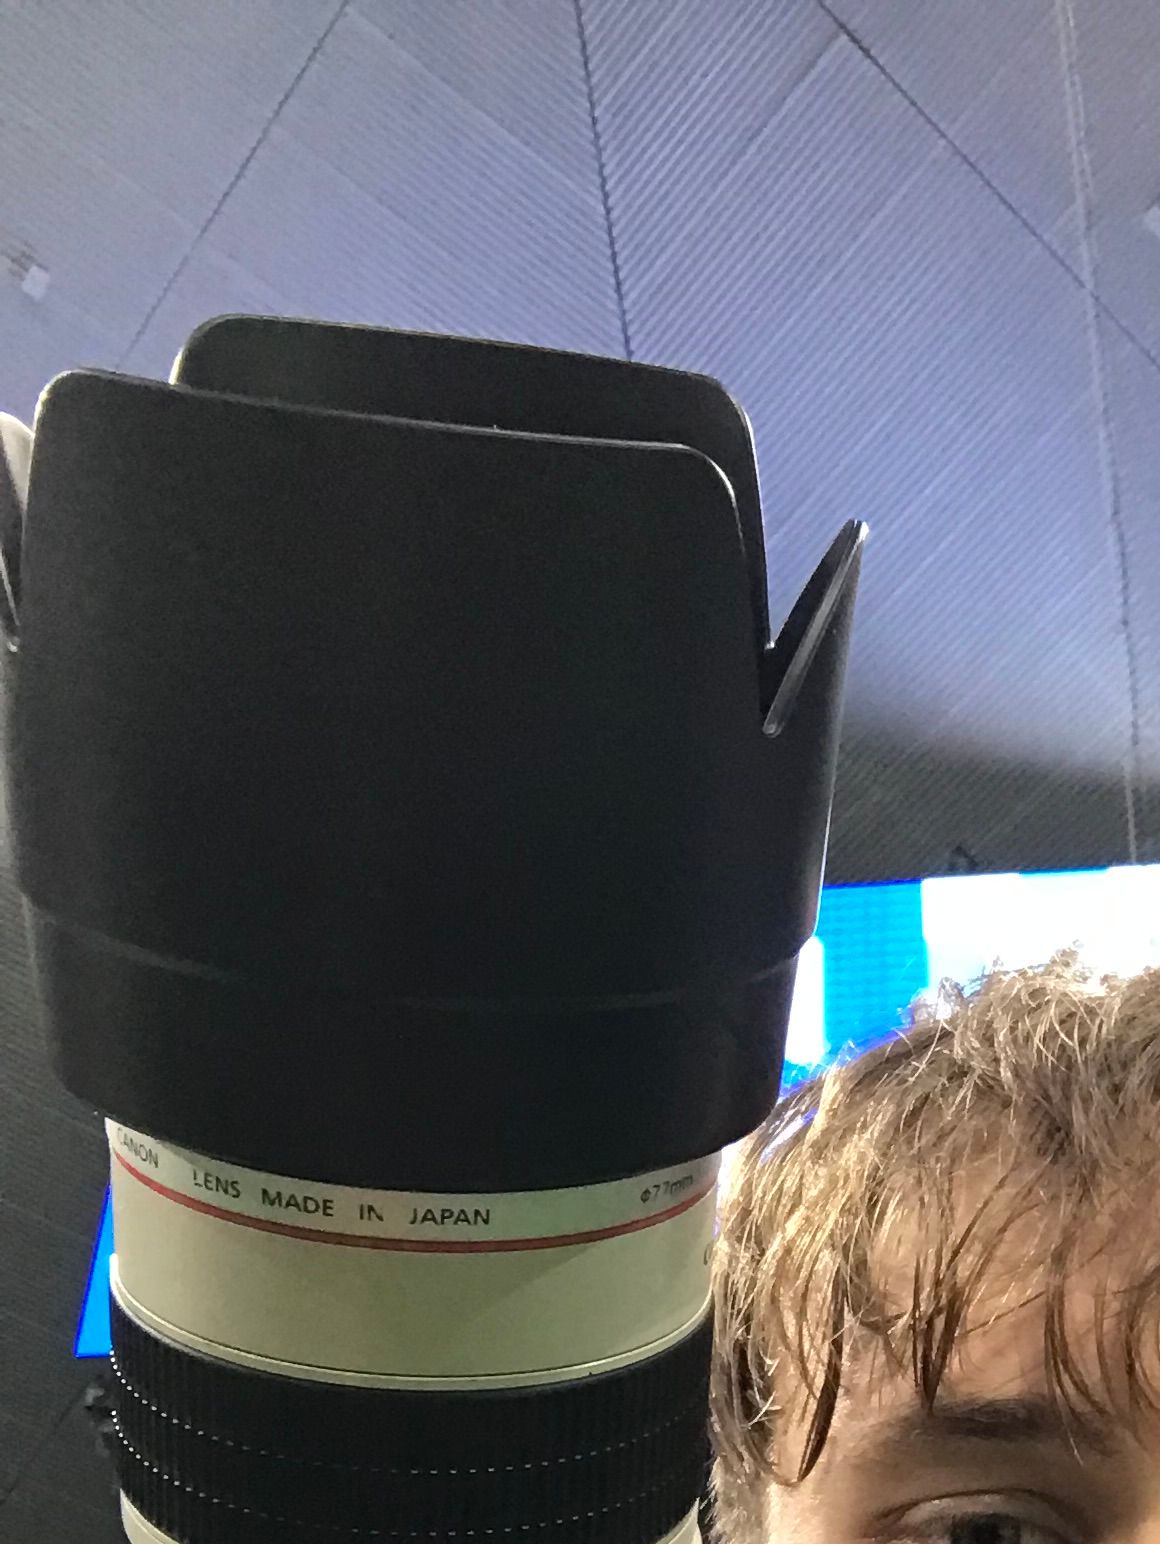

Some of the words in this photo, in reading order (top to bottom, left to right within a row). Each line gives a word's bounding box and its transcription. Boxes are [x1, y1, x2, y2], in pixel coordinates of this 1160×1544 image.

[192, 1168, 241, 1199] LENS
[261, 1187, 334, 1218] MADE
[359, 1203, 385, 1222] IN
[409, 1207, 491, 1226] JAPAN
